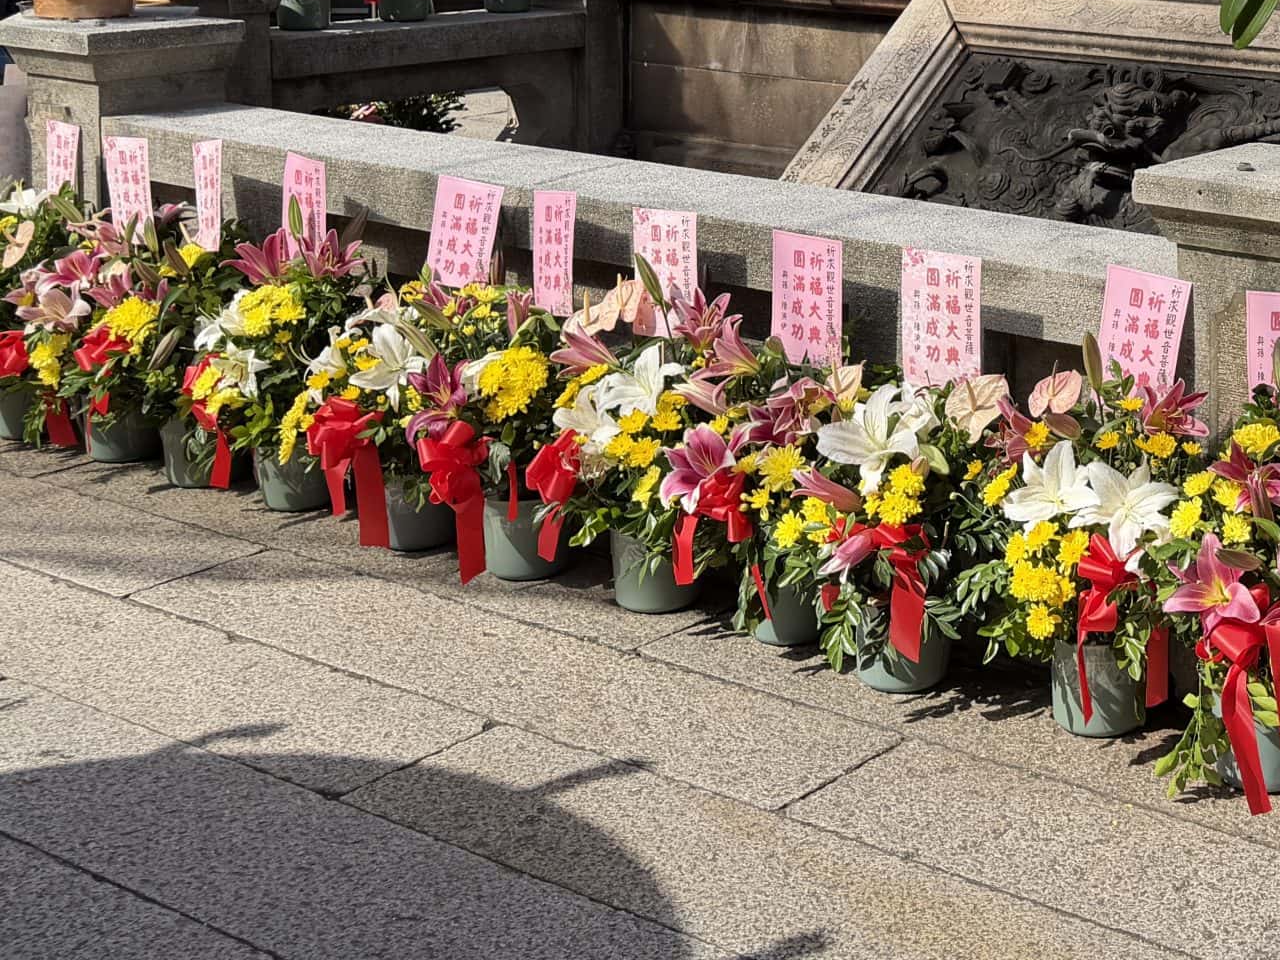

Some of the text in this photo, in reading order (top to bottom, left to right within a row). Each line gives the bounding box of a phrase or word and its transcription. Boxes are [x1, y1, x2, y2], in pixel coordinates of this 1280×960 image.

[443, 192, 465, 275] 圓滿成功
[457, 195, 484, 281] 祈福大典
[543, 205, 553, 290] 圓滿成功
[552, 204, 563, 290] 祈福大典
[791, 250, 807, 342] 圓滿成功
[808, 251, 824, 345] 祈福大典
[925, 267, 943, 363] 圓滿成功
[943, 268, 961, 367] 祈福大典
